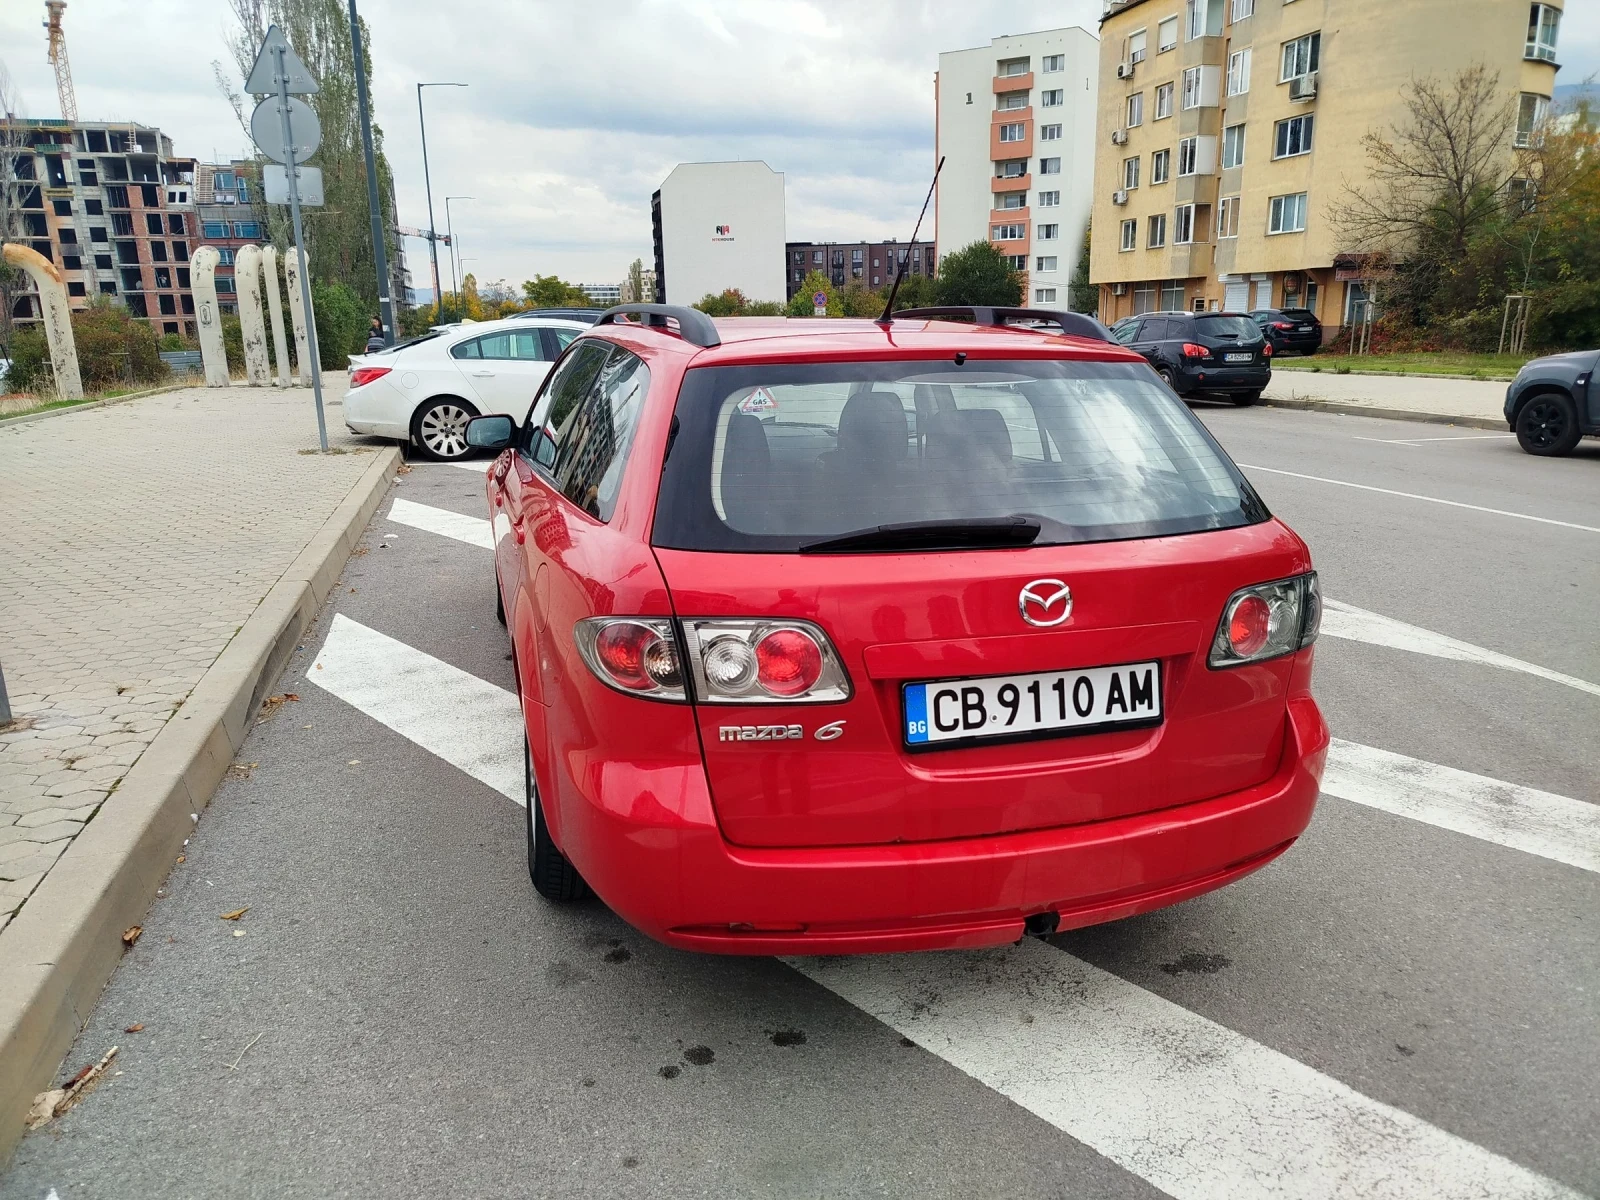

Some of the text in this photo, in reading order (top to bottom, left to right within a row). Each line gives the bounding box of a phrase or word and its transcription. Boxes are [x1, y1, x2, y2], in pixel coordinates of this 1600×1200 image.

[966, 92, 973, 105] 1
[752, 398, 768, 406] GAS
[933, 669, 1154, 733] CB 9110 AM
[813, 719, 847, 741] 6
[908, 720, 927, 735] BG
